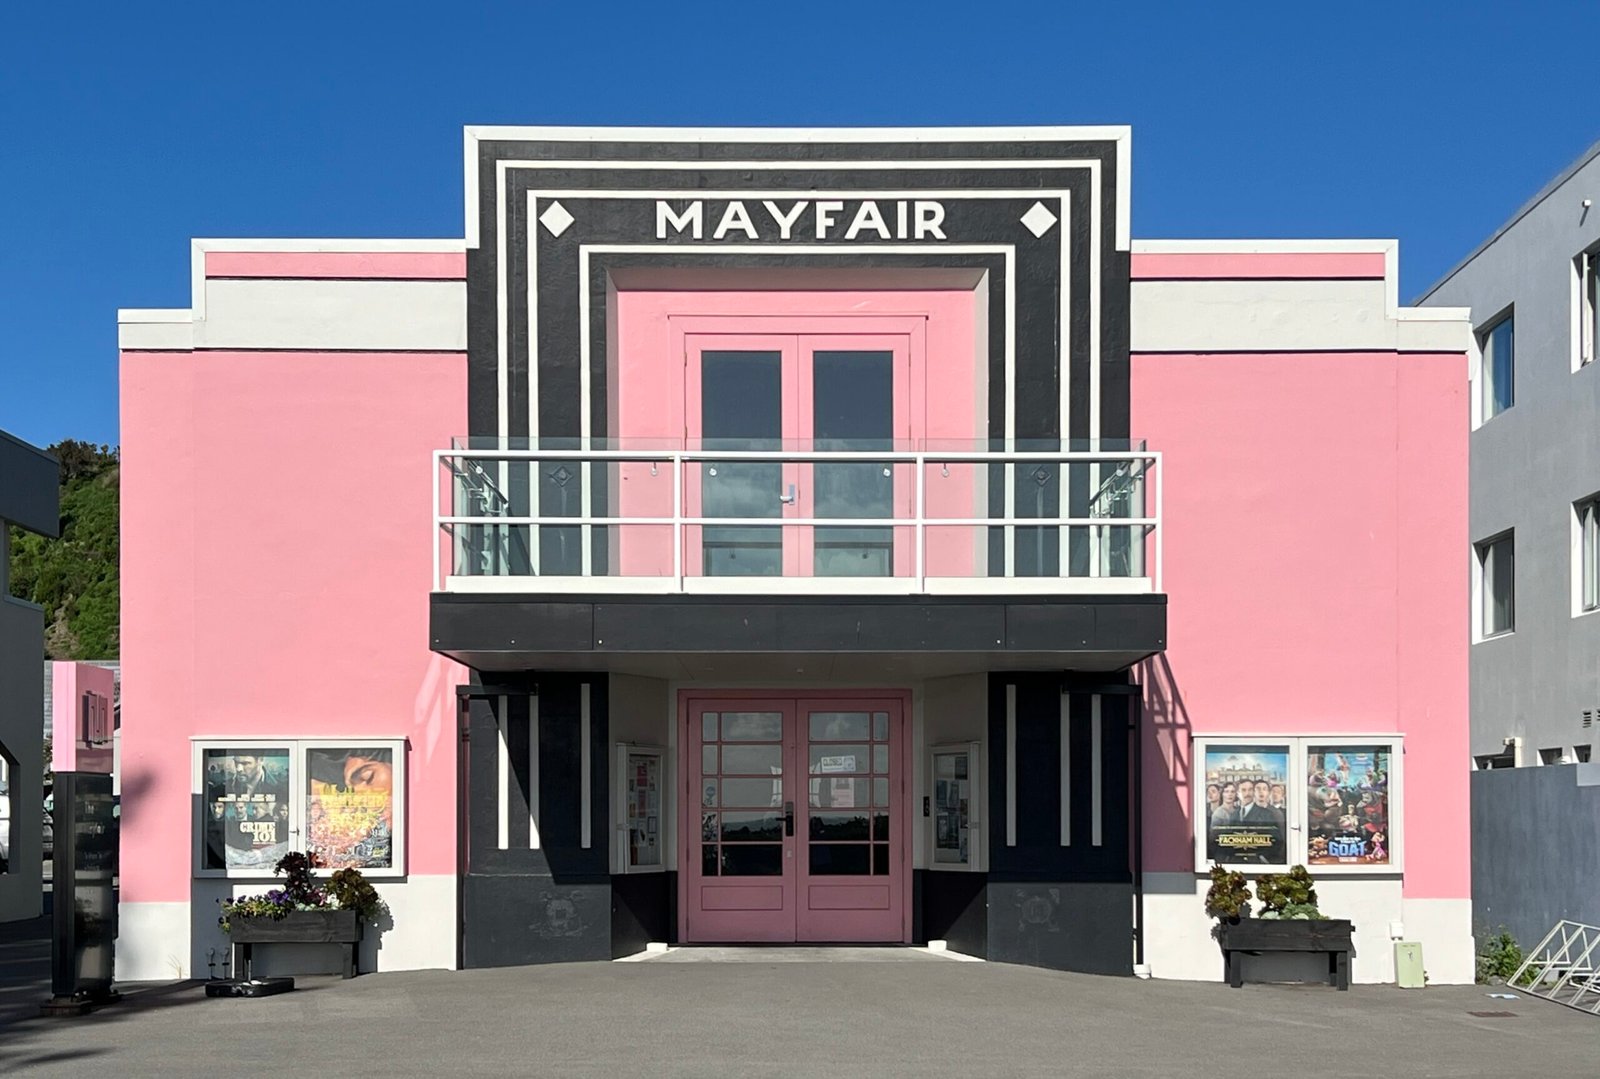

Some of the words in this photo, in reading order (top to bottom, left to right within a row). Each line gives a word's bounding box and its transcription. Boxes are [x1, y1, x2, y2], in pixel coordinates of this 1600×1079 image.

[656, 201, 947, 239] MAYFAIR
[240, 822, 276, 833] CRIME
[253, 832, 276, 842] 101
[1328, 840, 1367, 857] GOAT
